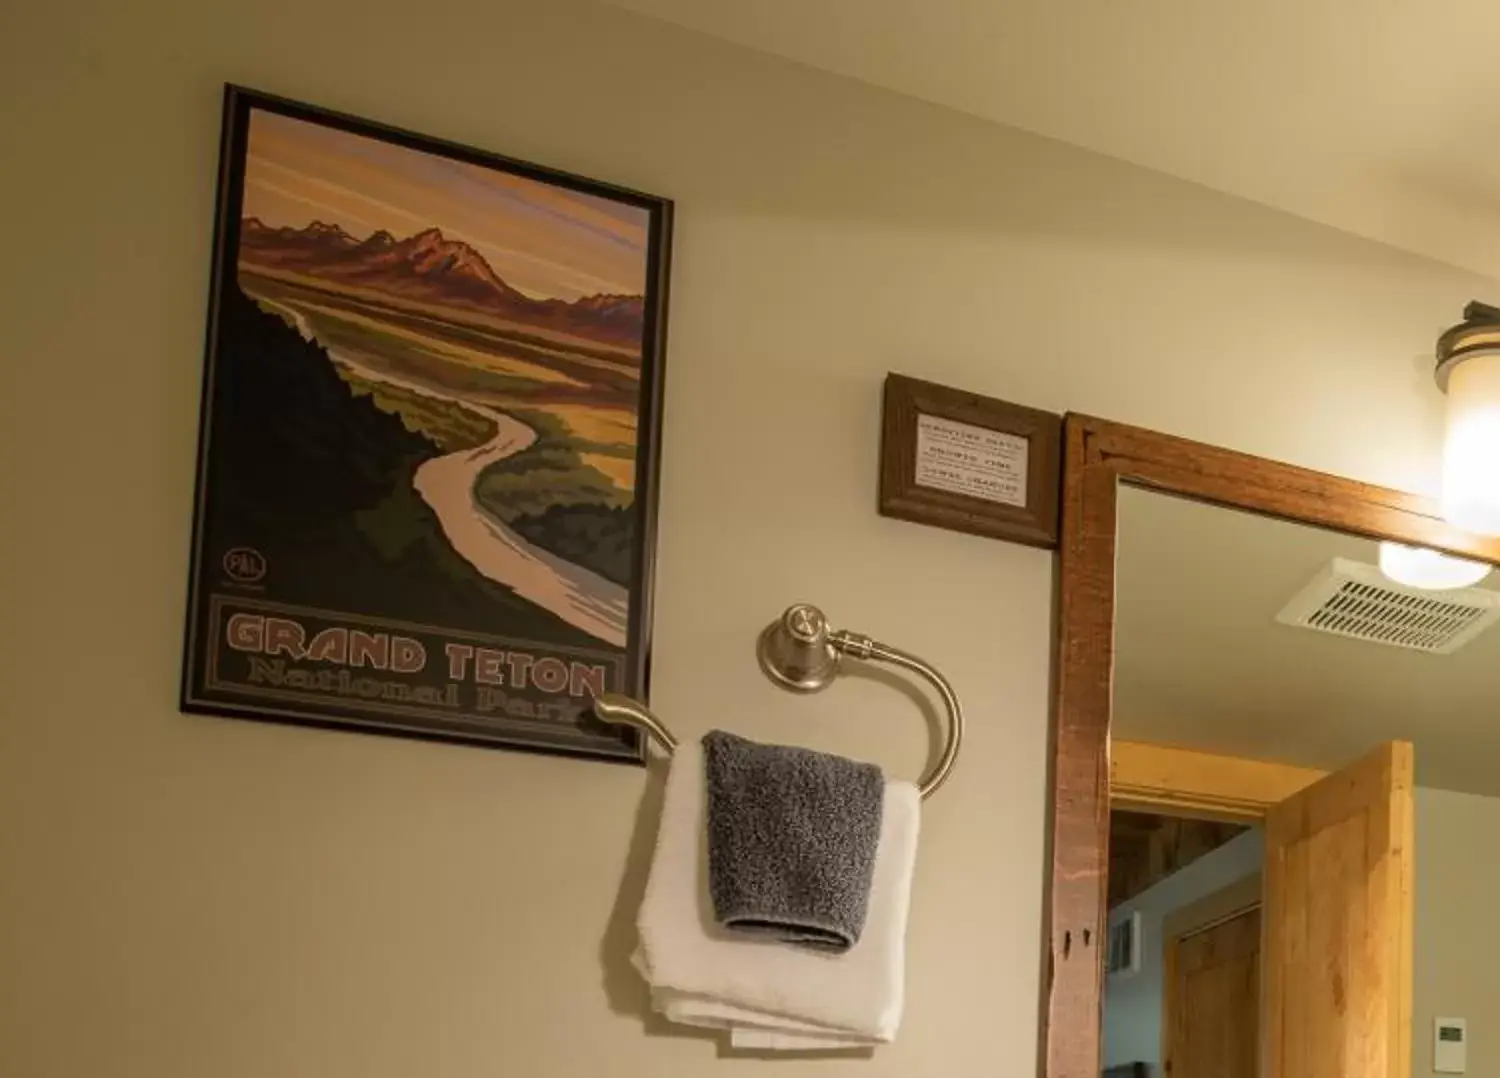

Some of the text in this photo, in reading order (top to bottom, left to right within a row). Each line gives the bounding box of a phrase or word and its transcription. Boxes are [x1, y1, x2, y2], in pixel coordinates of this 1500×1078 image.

[227, 613, 606, 698] GRAND TETON
[247, 656, 460, 706] National
